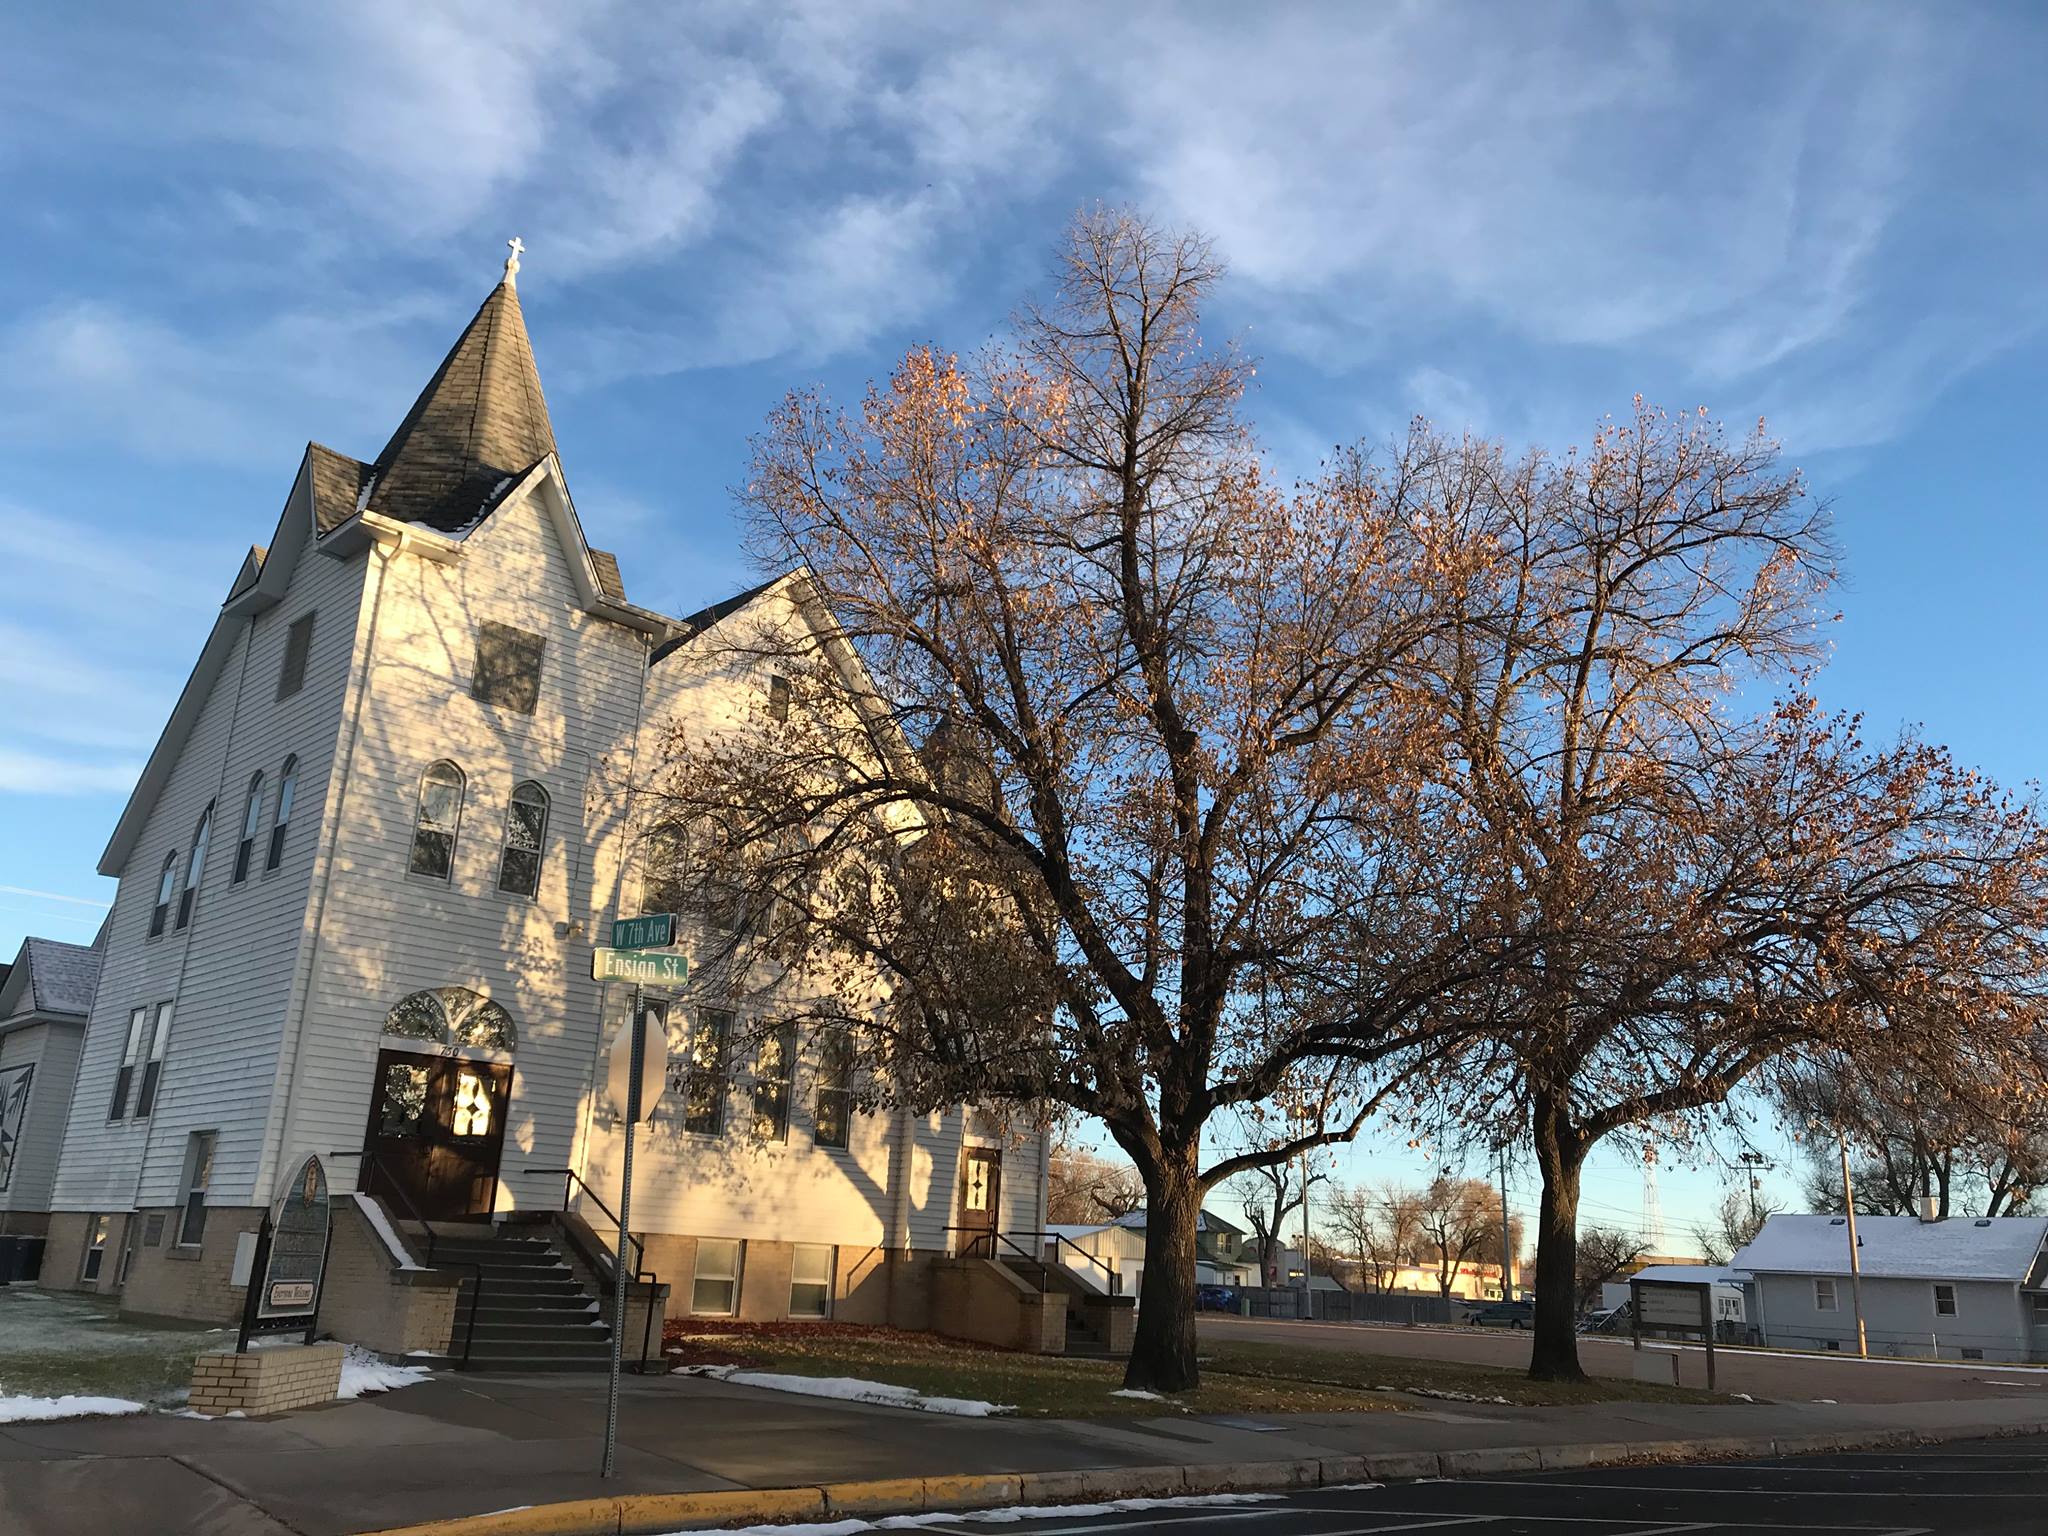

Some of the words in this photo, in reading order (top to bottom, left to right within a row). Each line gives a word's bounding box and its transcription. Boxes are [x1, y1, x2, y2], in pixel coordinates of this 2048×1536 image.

[616, 924, 624, 946] W
[628, 922, 643, 944] 7th
[647, 920, 666, 942] Ave
[605, 952, 656, 980] Ensign
[662, 957, 679, 980] St
